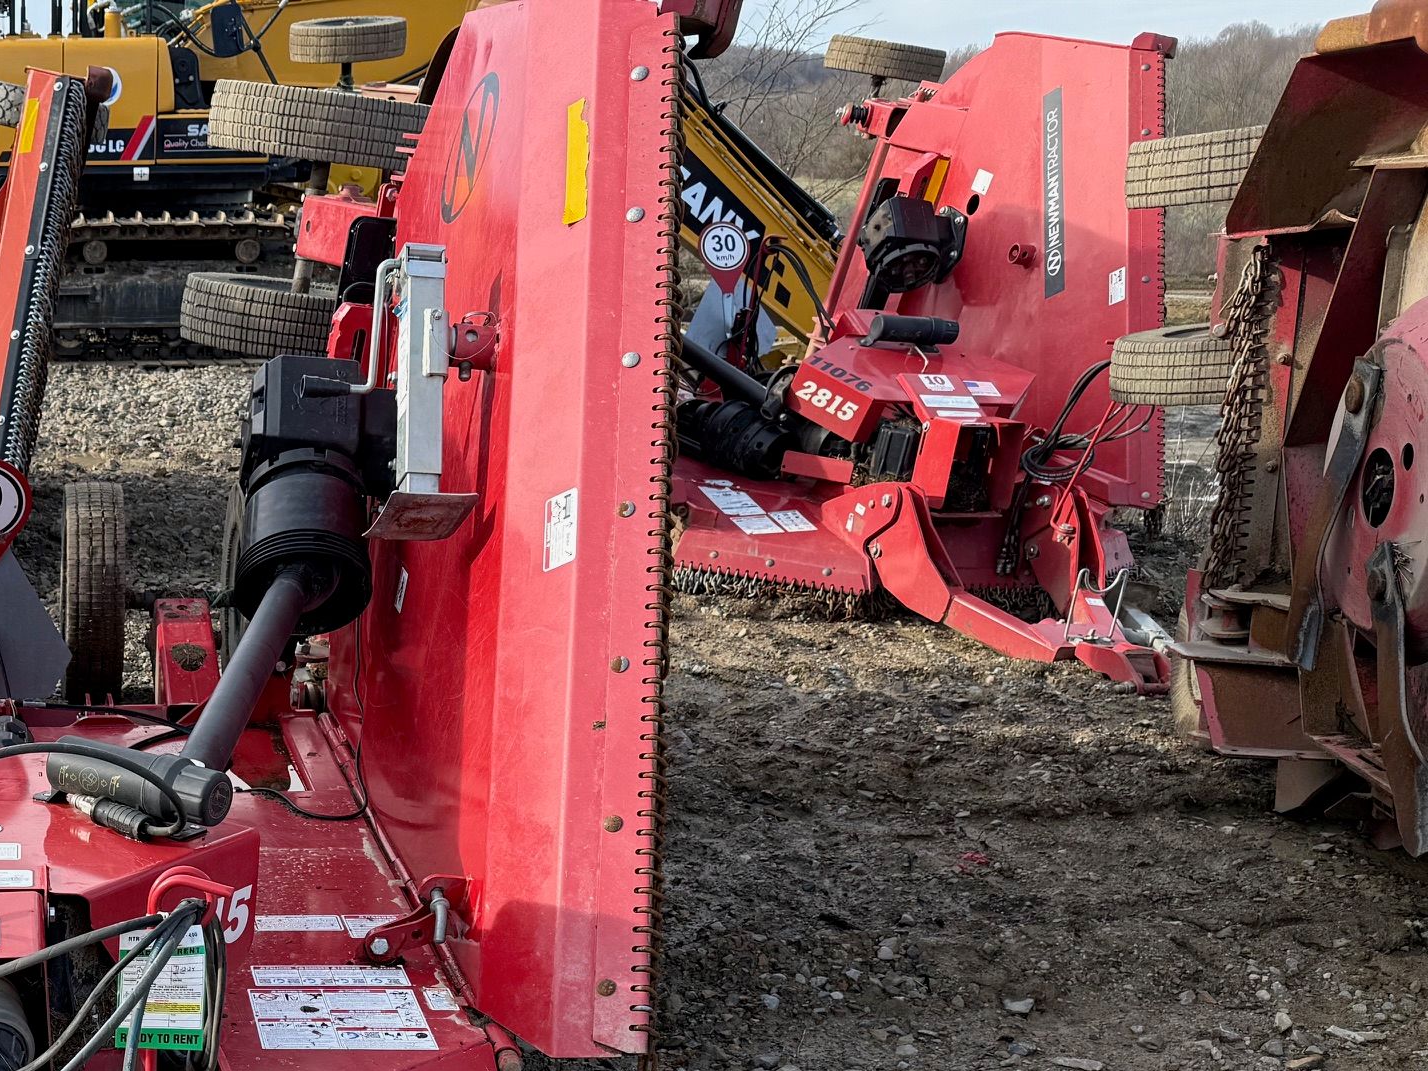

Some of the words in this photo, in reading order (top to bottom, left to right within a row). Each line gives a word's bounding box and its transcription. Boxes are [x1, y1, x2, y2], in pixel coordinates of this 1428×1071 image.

[711, 234, 736, 253] 30
[809, 355, 873, 392] 11076
[924, 375, 946, 386] 10
[794, 380, 860, 422] 2815
[177, 946, 201, 955] RENT
[120, 1033, 154, 1043] RDY
[157, 1033, 170, 1044] TO
[173, 1034, 200, 1045] RENT
